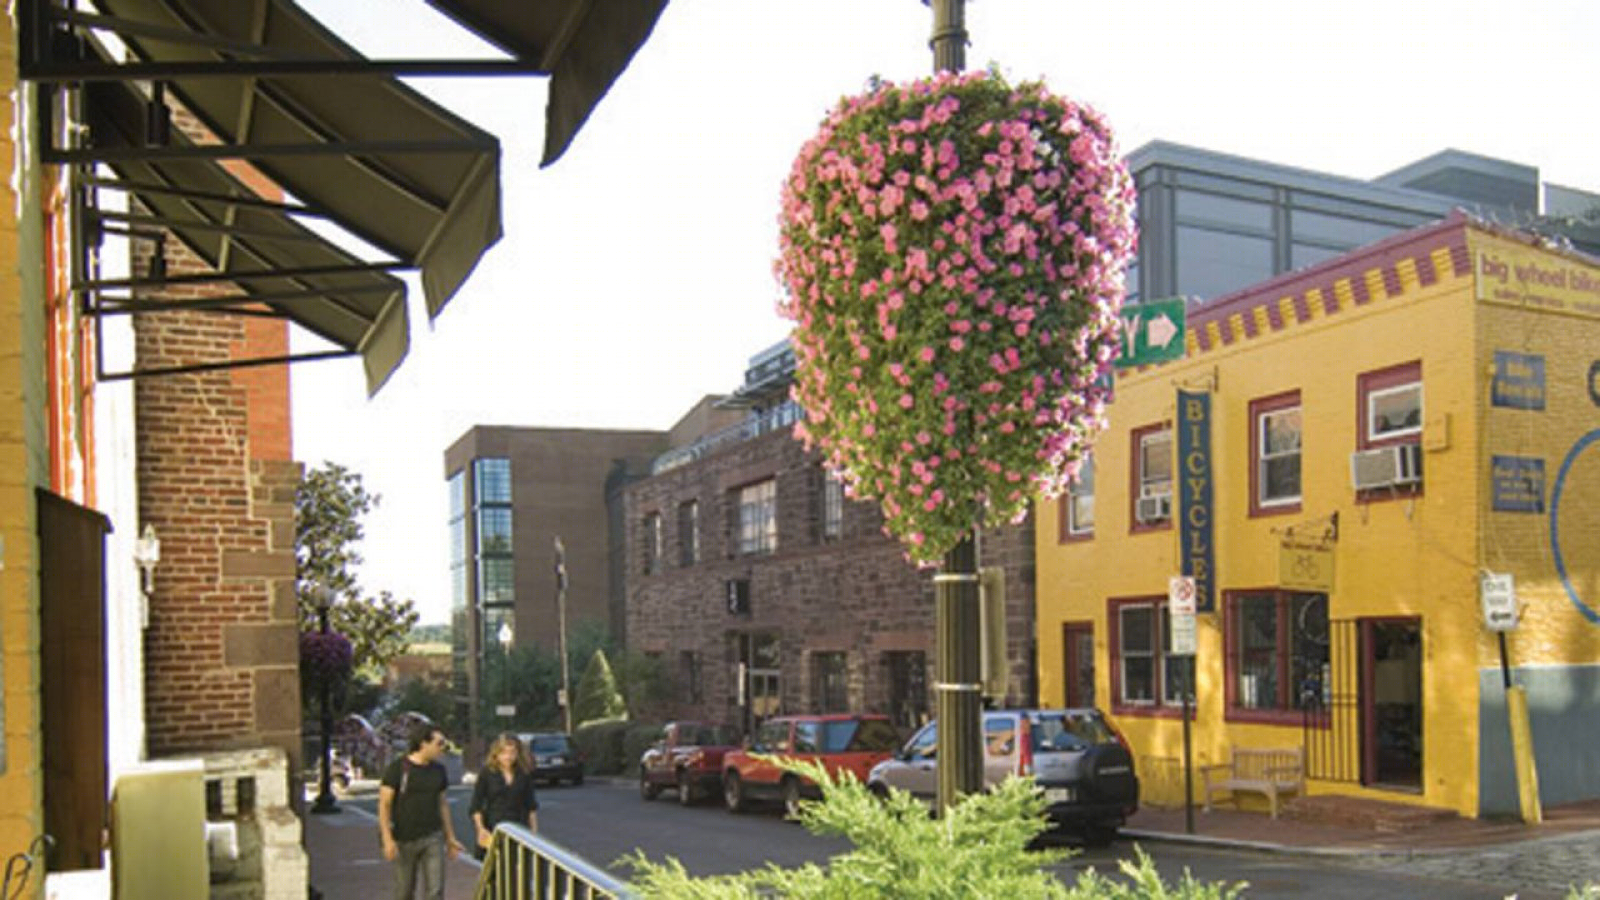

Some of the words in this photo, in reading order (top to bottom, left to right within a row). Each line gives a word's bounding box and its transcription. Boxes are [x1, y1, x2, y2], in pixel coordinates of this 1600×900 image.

[1481, 253, 1508, 284] big
[1514, 262, 1566, 288] wheel
[1186, 399, 1208, 606] BICYCLES
